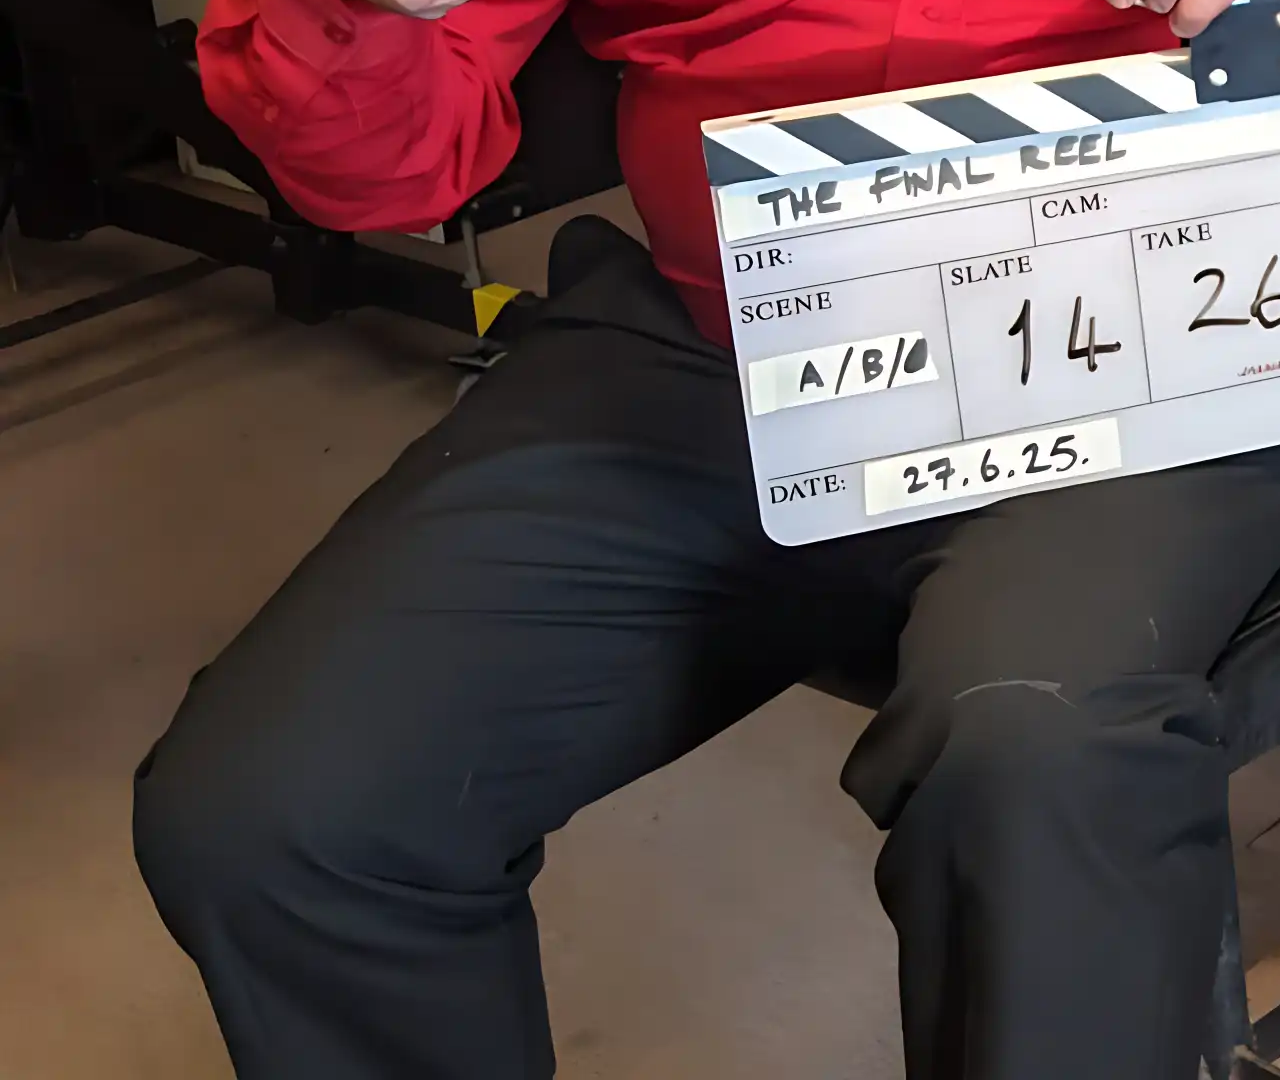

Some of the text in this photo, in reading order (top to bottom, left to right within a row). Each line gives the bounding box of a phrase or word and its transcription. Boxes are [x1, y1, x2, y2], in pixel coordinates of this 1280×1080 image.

[757, 130, 1128, 227] THE FINAL REEL
[1041, 194, 1109, 220] CAM:
[1141, 223, 1213, 252] TAKE
[733, 248, 793, 274] DIR:
[950, 256, 1033, 287] SLATE
[739, 291, 833, 325] SCENE
[1008, 296, 1122, 386] 14
[769, 476, 847, 505] DATE:
